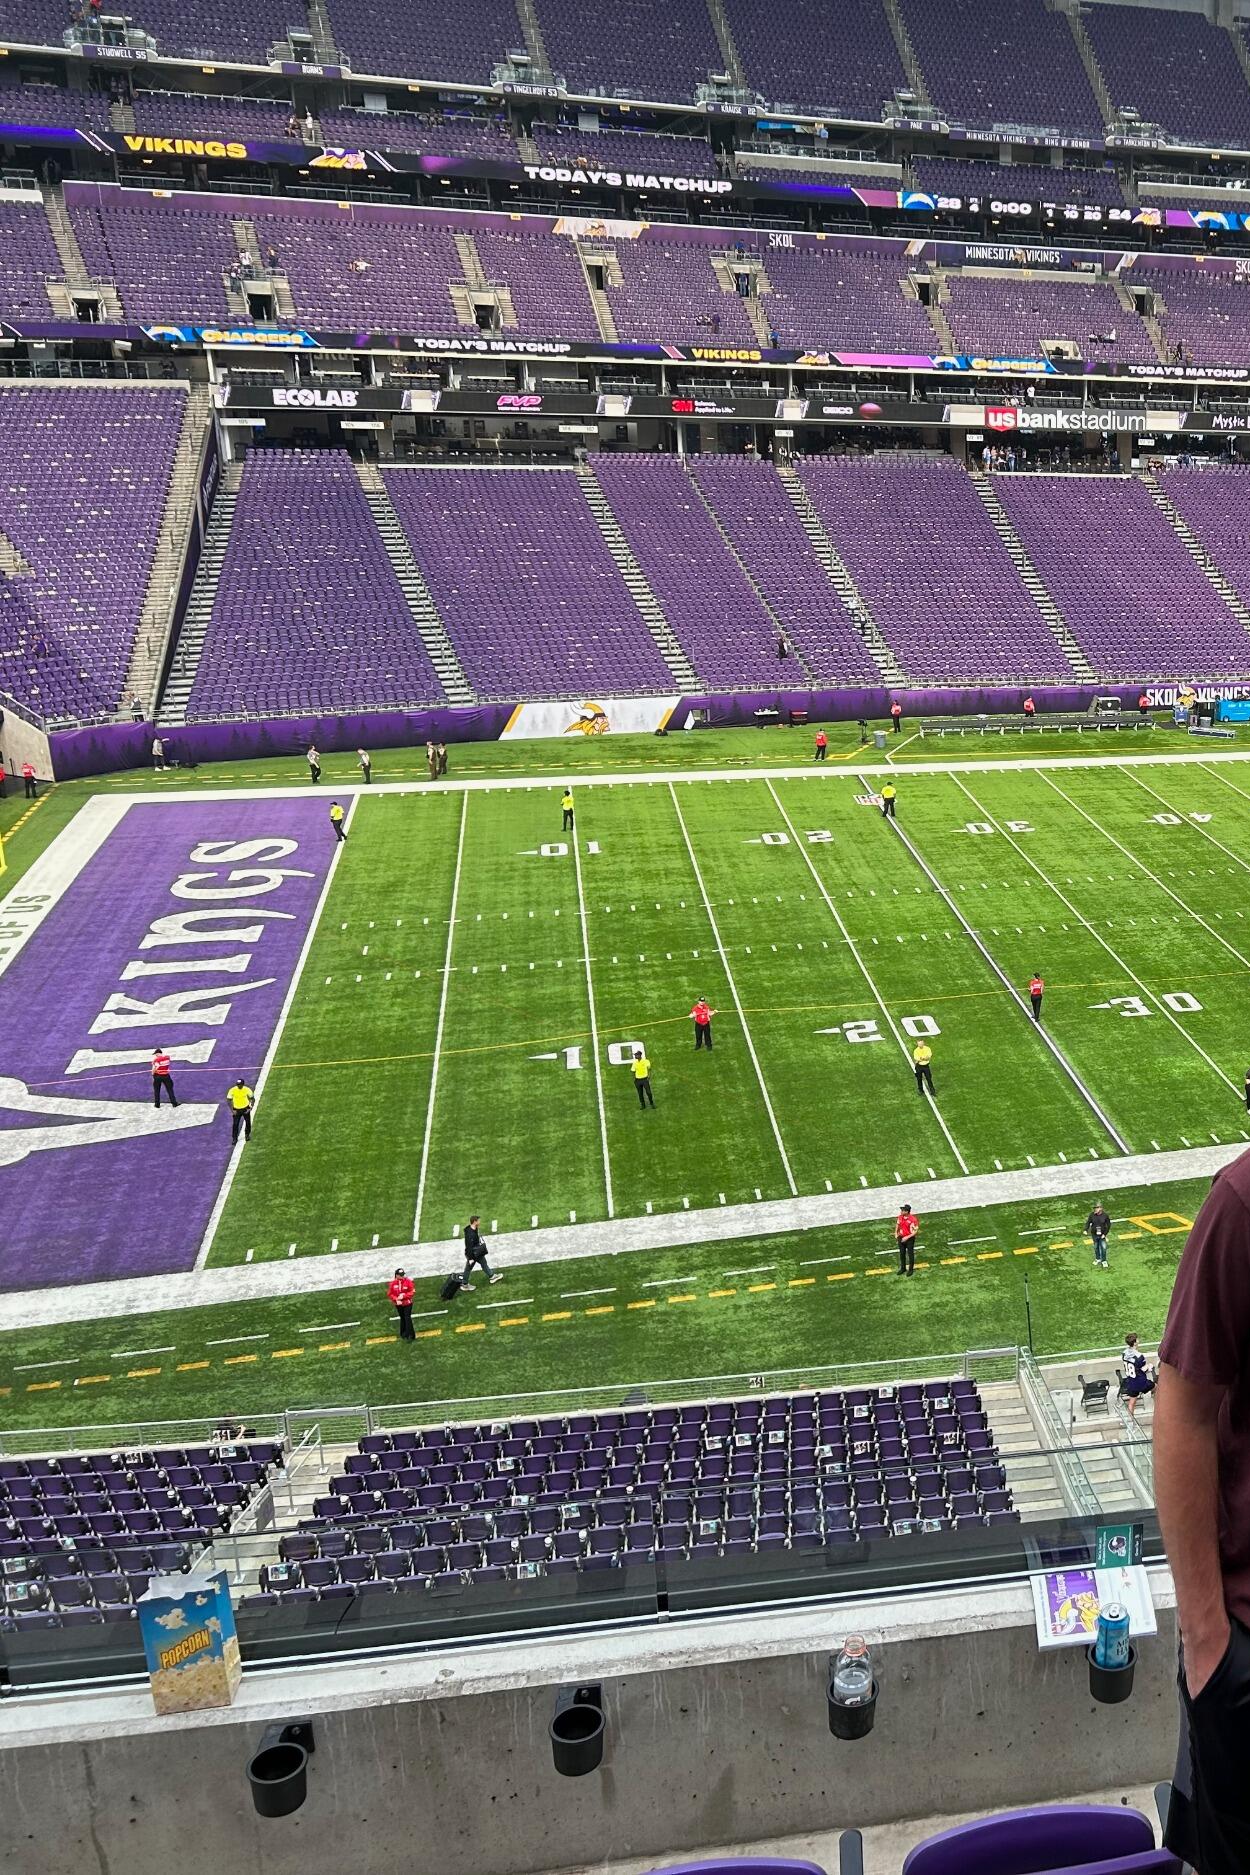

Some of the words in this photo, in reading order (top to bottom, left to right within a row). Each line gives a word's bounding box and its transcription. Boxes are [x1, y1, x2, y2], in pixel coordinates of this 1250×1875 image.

[97, 47, 132, 59] STUDWELL
[547, 87, 558, 97] 53
[966, 131, 1000, 142] MINNESOTA
[1002, 134, 1027, 144] VIKINGS
[123, 135, 247, 159] VIKINGS
[523, 166, 623, 186] TODAY'S
[625, 174, 733, 194] MATCHUP
[937, 197, 962, 209] 28
[969, 203, 980, 213] 4
[990, 201, 1032, 215] 0:00
[1063, 210, 1079, 220] 10
[1083, 211, 1101, 221] 20
[1108, 208, 1132, 221] 24
[768, 232, 796, 248] SKOL
[965, 246, 1015, 261] MINNESOTA
[1025, 250, 1060, 264] VIKINGS
[201, 329, 304, 345] CHARGERS
[413, 338, 488, 351] TODAY'S
[490, 341, 571, 353] MATCHUP
[691, 348, 762, 361] VIKINGS
[971, 358, 1047, 371] CHARGERS
[1128, 365, 1183, 377] TODAY'S
[1185, 368, 1248, 378] MATCHUP
[272, 389, 357, 407] ECOLAB
[496, 395, 543, 407] FVP
[671, 400, 693, 412] 3M
[1146, 688, 1180, 706] SKOL
[1106, 990, 1203, 1018] 30
[834, 1014, 942, 1044] 20
[561, 1040, 646, 1072] 10
[1123, 1361, 1137, 1379] 18
[161, 1629, 211, 1670] POPCORN
